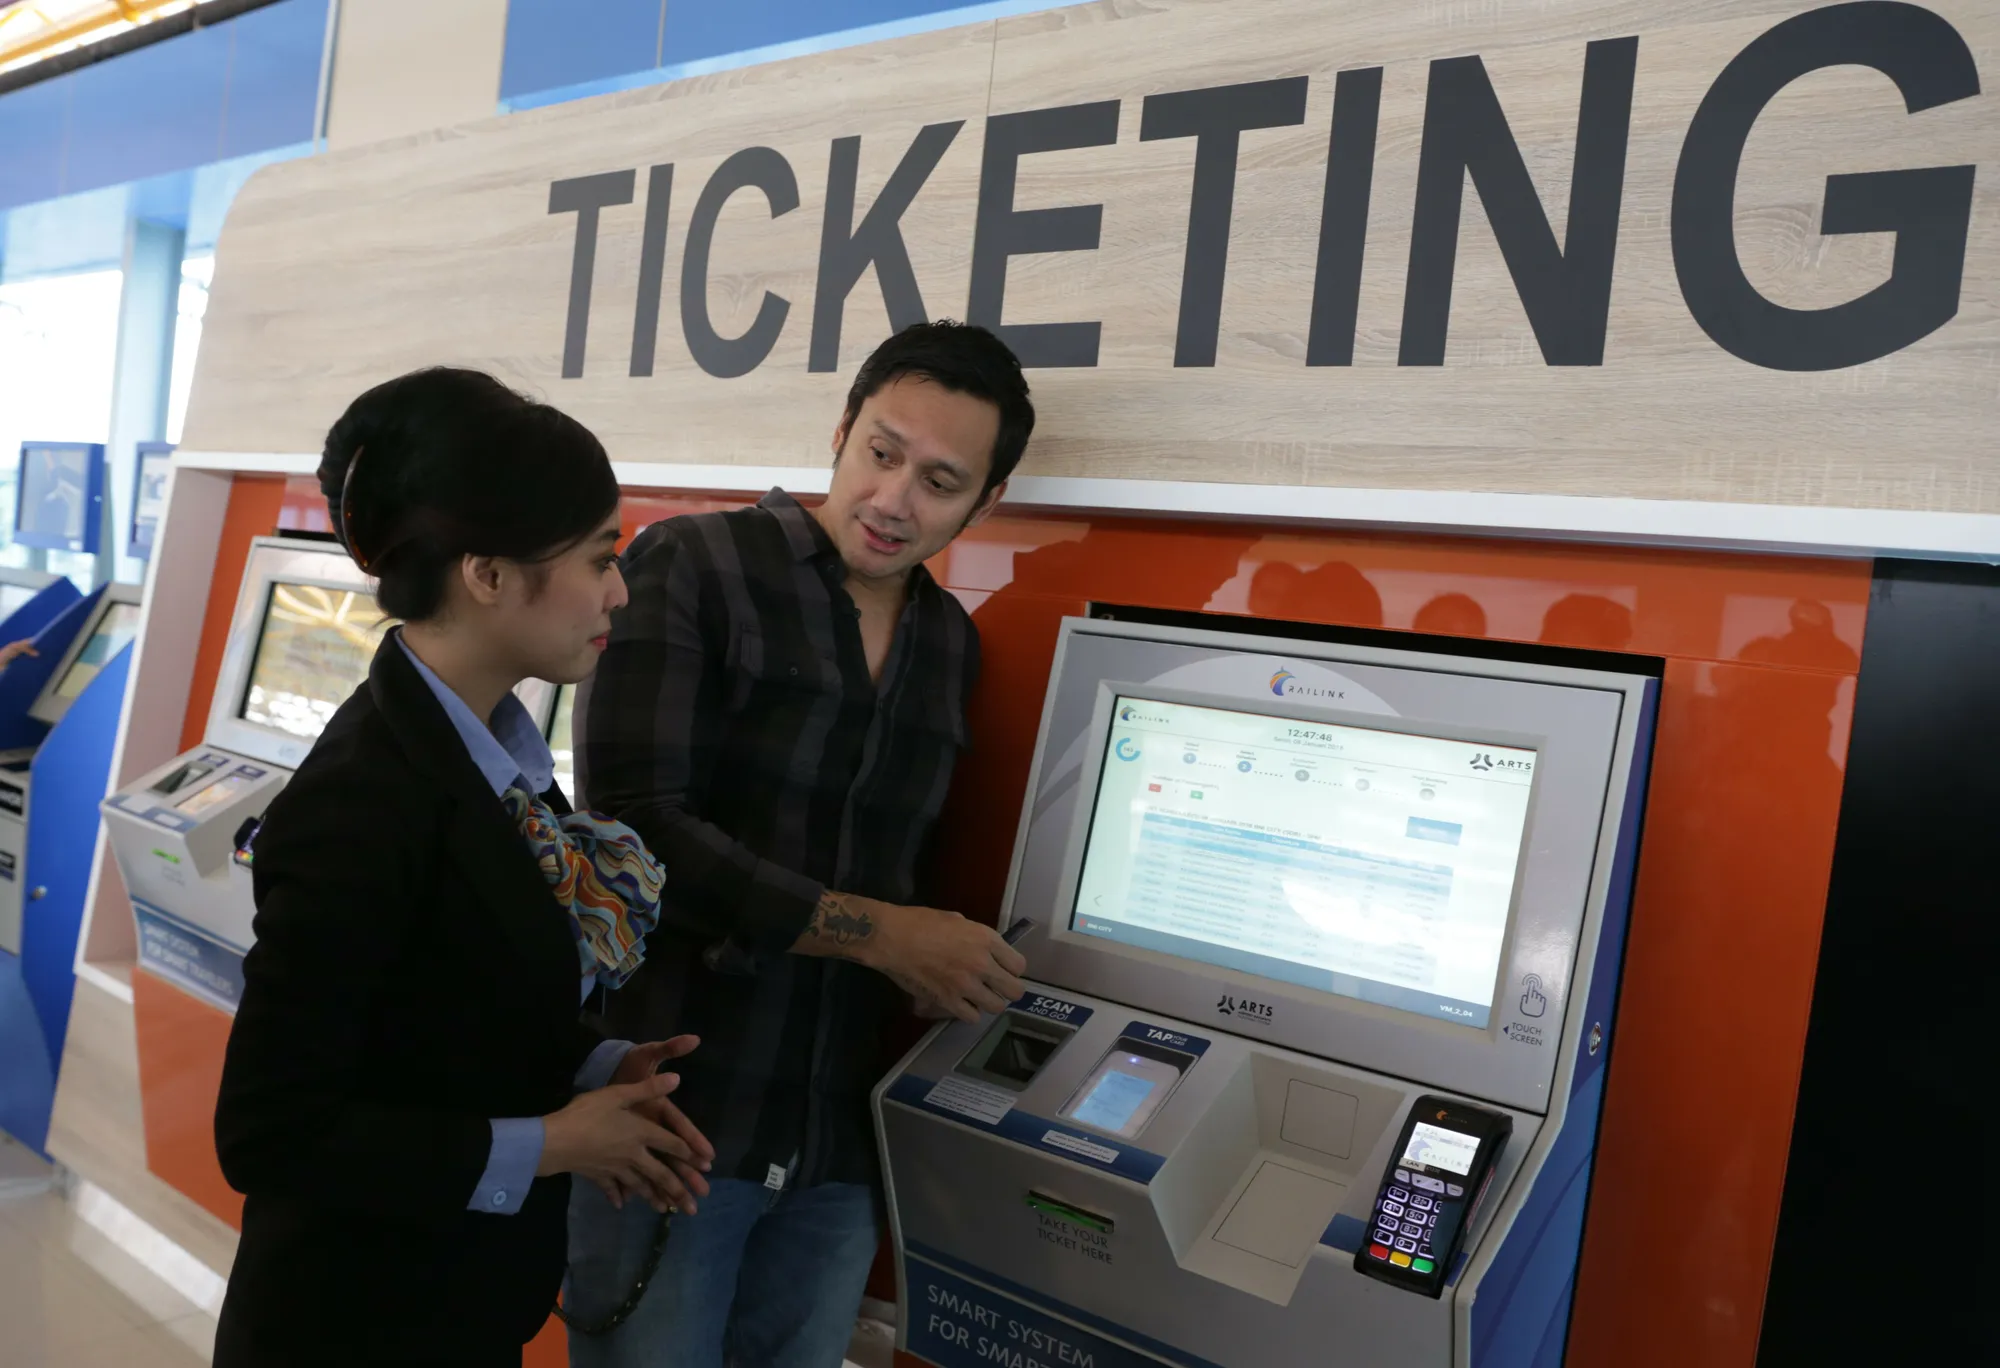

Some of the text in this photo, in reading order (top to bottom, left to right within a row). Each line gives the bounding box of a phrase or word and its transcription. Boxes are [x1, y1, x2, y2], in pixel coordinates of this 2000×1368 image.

[548, 0, 1981, 379] TICKETING
[1288, 684, 1346, 700] RAILINK
[1287, 728, 1333, 742] 12:47:48
[1497, 758, 1532, 770] ARTS
[1026, 1005, 1069, 1021] AND GO!
[1033, 997, 1075, 1014] SCAN
[1239, 999, 1273, 1016] ARTS
[1146, 1028, 1174, 1042] TAP
[1512, 1022, 1542, 1035] TOUCH
[1510, 1033, 1543, 1046] SCREEN
[1038, 1214, 1108, 1248] TAKE YOUR
[1037, 1227, 1113, 1265] TICKET HERE
[927, 1284, 1094, 1368] SMART SYSTEM
[928, 1314, 1051, 1368] FOR SMAR
